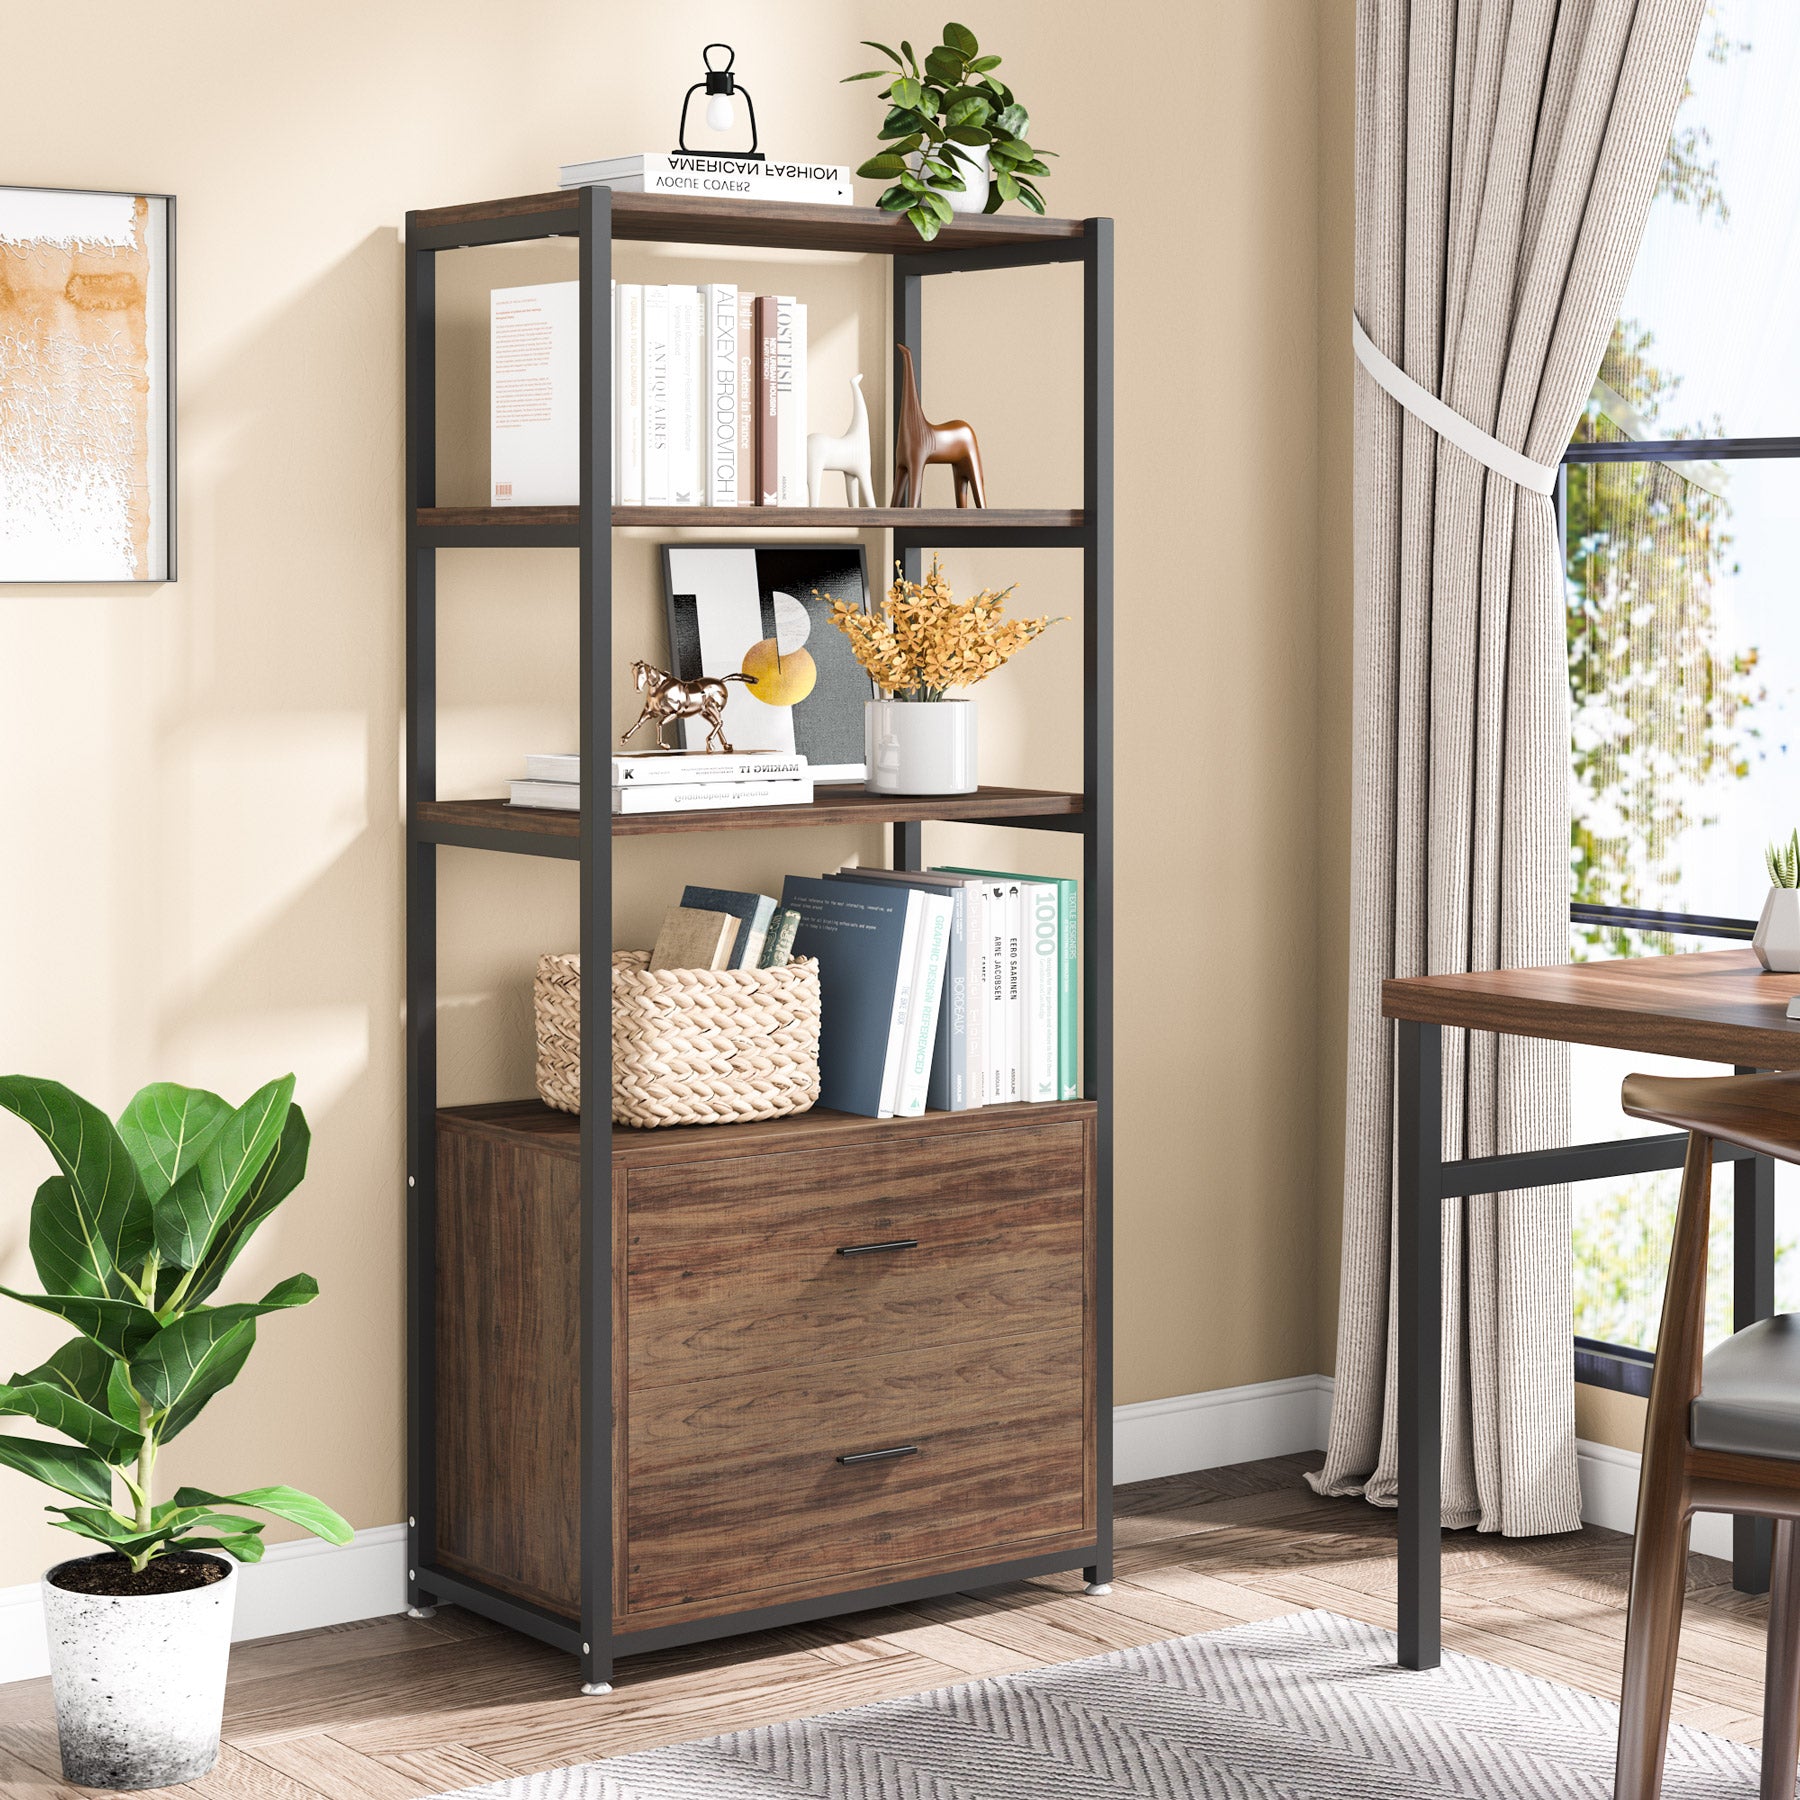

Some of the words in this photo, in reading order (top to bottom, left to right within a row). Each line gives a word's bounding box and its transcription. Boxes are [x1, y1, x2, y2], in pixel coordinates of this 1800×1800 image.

[716, 289, 735, 363] ALEXEY
[777, 302, 793, 349] LOST
[652, 341, 666, 450] ANTIQUAIRES
[740, 356, 751, 400] Gardens
[741, 402, 751, 412] in
[716, 370, 735, 493] BRODOVITCH
[741, 415, 751, 449] France
[929, 915, 945, 962] GRAPHIC
[994, 936, 1002, 957] ARNE
[1036, 893, 1056, 956] 1000
[1009, 937, 1018, 958] EERO
[924, 964, 938, 1003] DESIGN
[994, 959, 1002, 1001] JACOBSEN
[1009, 960, 1018, 1000] SAARINEN
[953, 977, 964, 1035] BORDEAUX
[914, 1005, 933, 1075] REFERENCED
